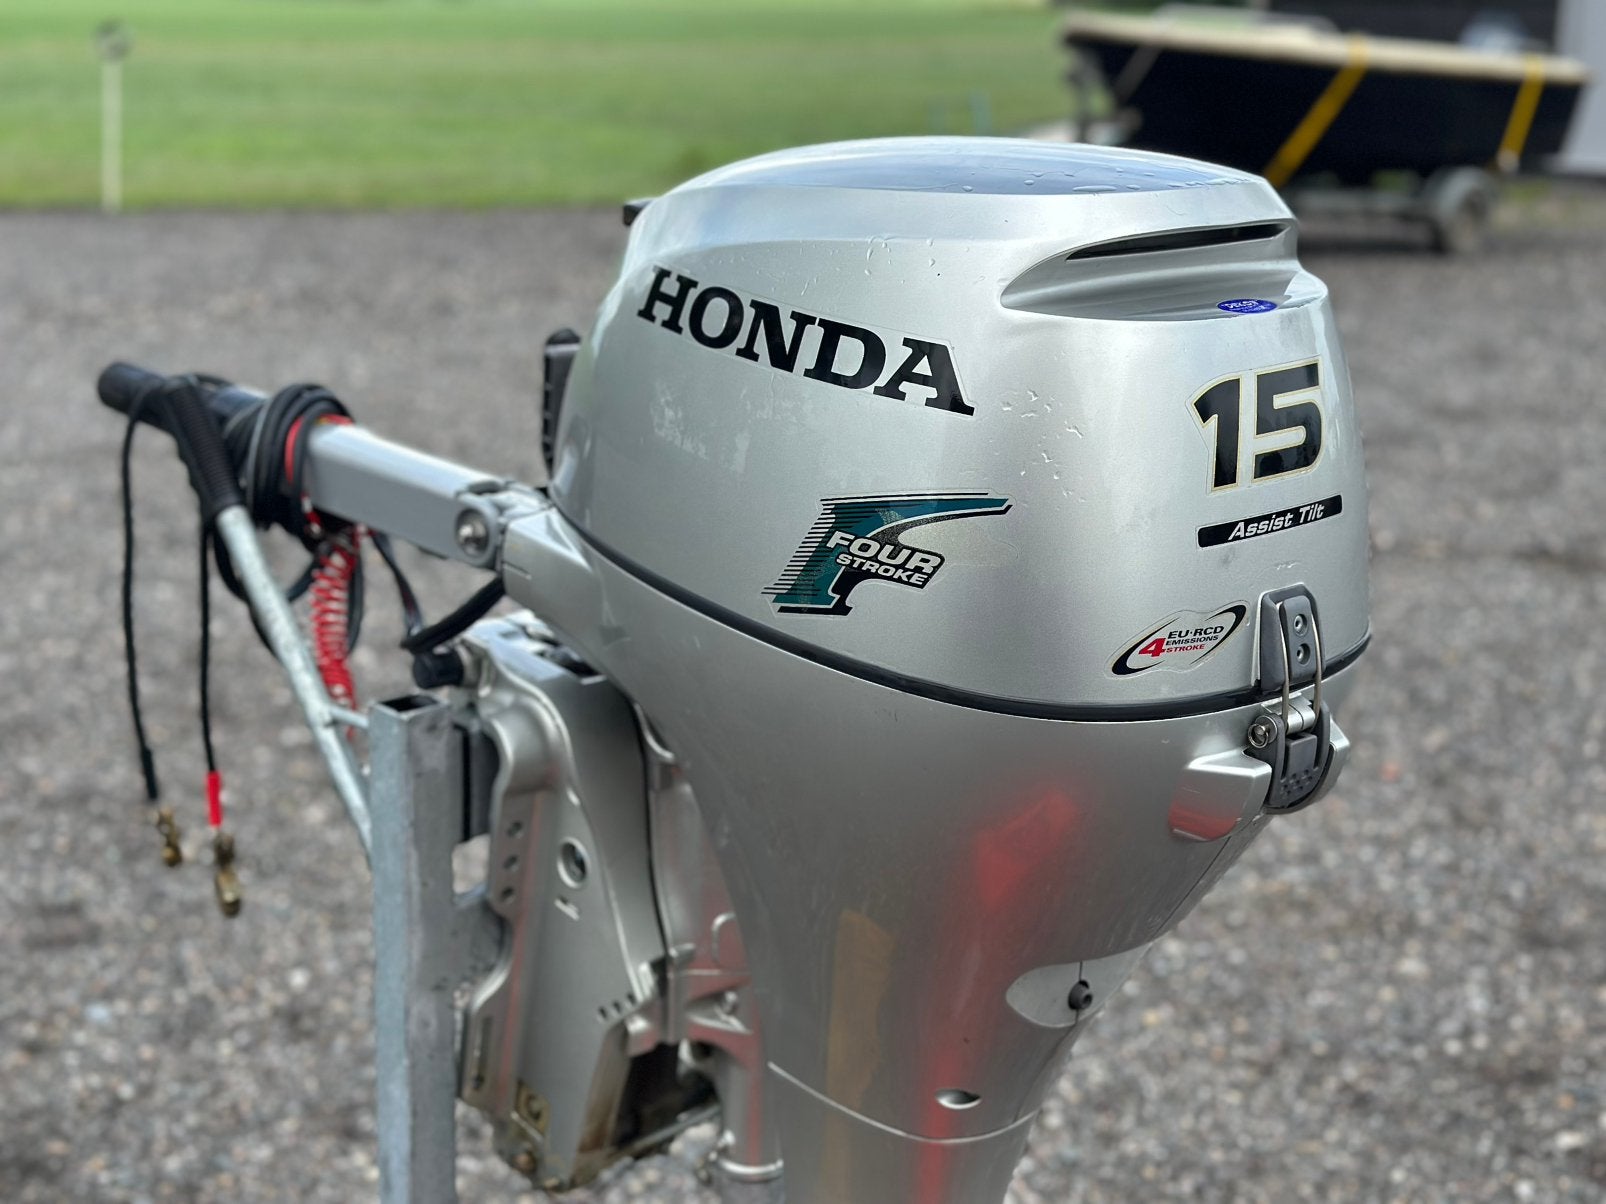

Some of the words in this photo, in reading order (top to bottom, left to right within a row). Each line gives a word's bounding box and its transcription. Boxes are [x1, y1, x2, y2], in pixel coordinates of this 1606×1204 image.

[637, 266, 975, 417] HONDA
[1192, 359, 1324, 489] 15
[1228, 512, 1294, 541] Assist
[1298, 503, 1325, 524] Tilt
[826, 530, 943, 574] FOUR
[836, 553, 929, 586] STROKE
[1138, 637, 1166, 658] 4
[1166, 643, 1206, 653] STROKE
[1165, 634, 1219, 646] EMISSIONS
